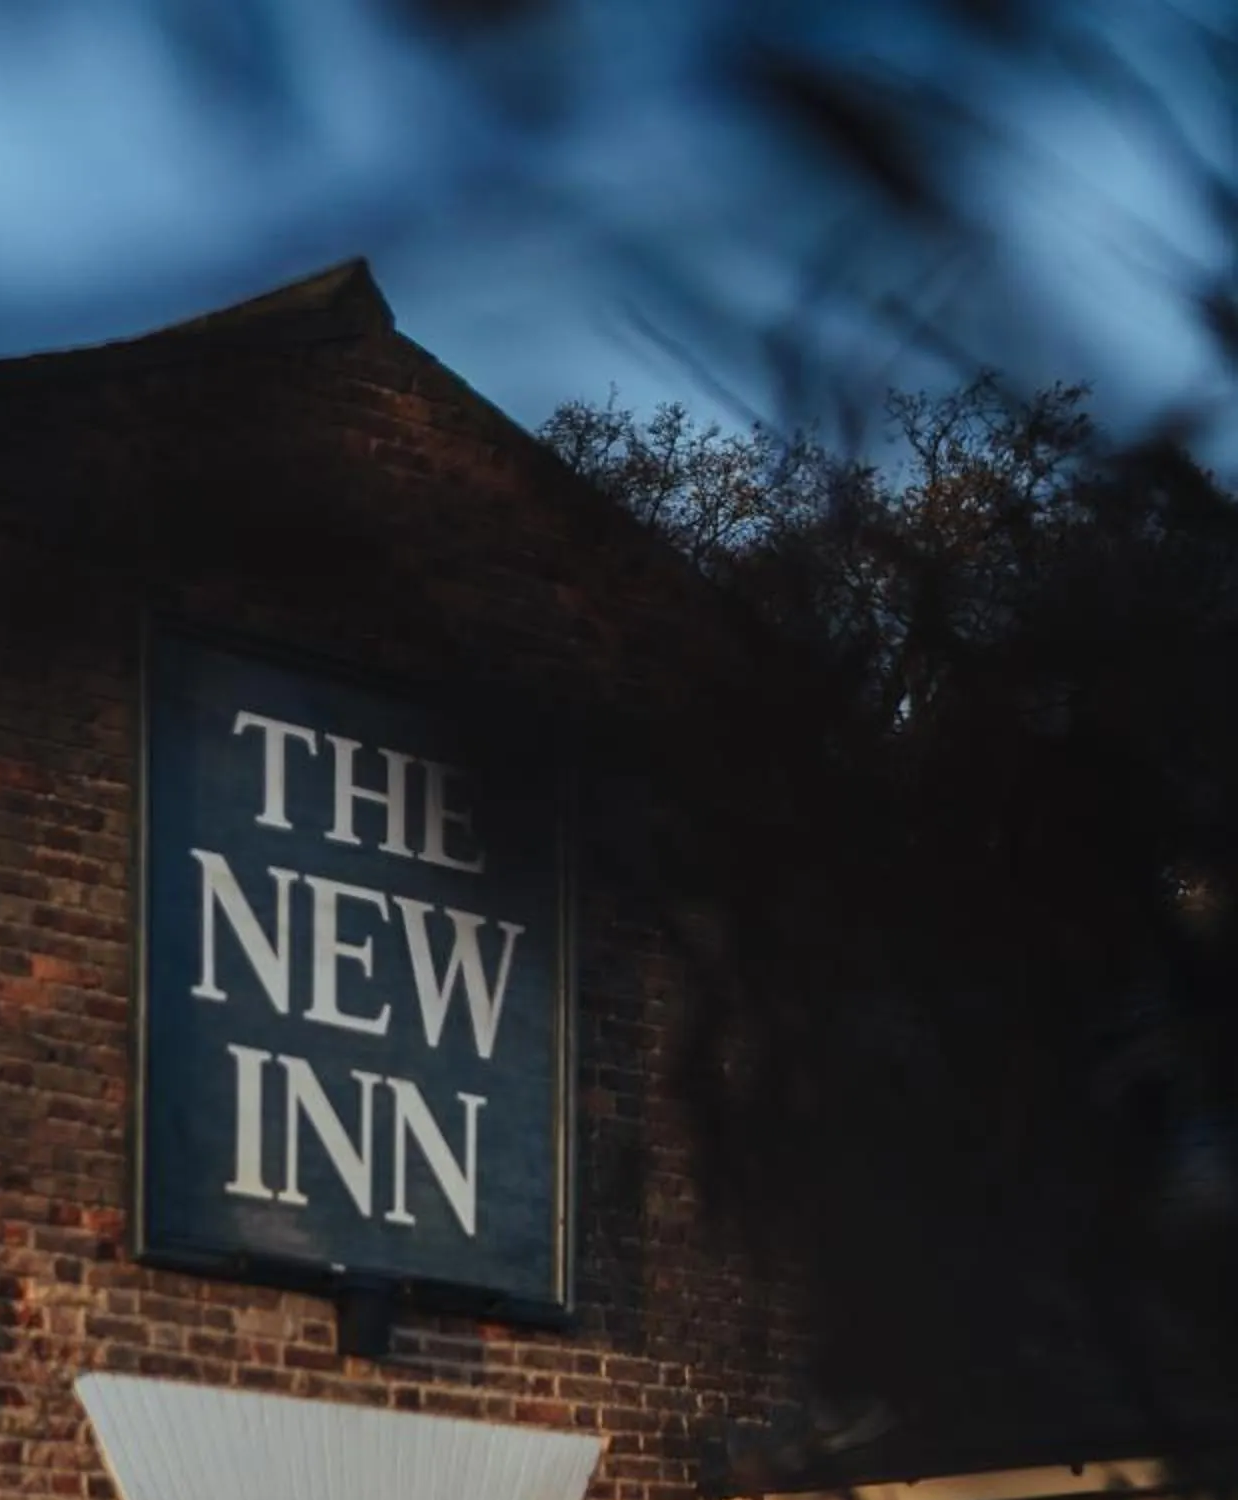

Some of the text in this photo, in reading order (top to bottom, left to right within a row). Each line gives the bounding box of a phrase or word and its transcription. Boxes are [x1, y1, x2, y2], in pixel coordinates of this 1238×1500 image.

[232, 709, 488, 874] THE
[189, 847, 526, 1060] NEW
[223, 1043, 488, 1237] INN
